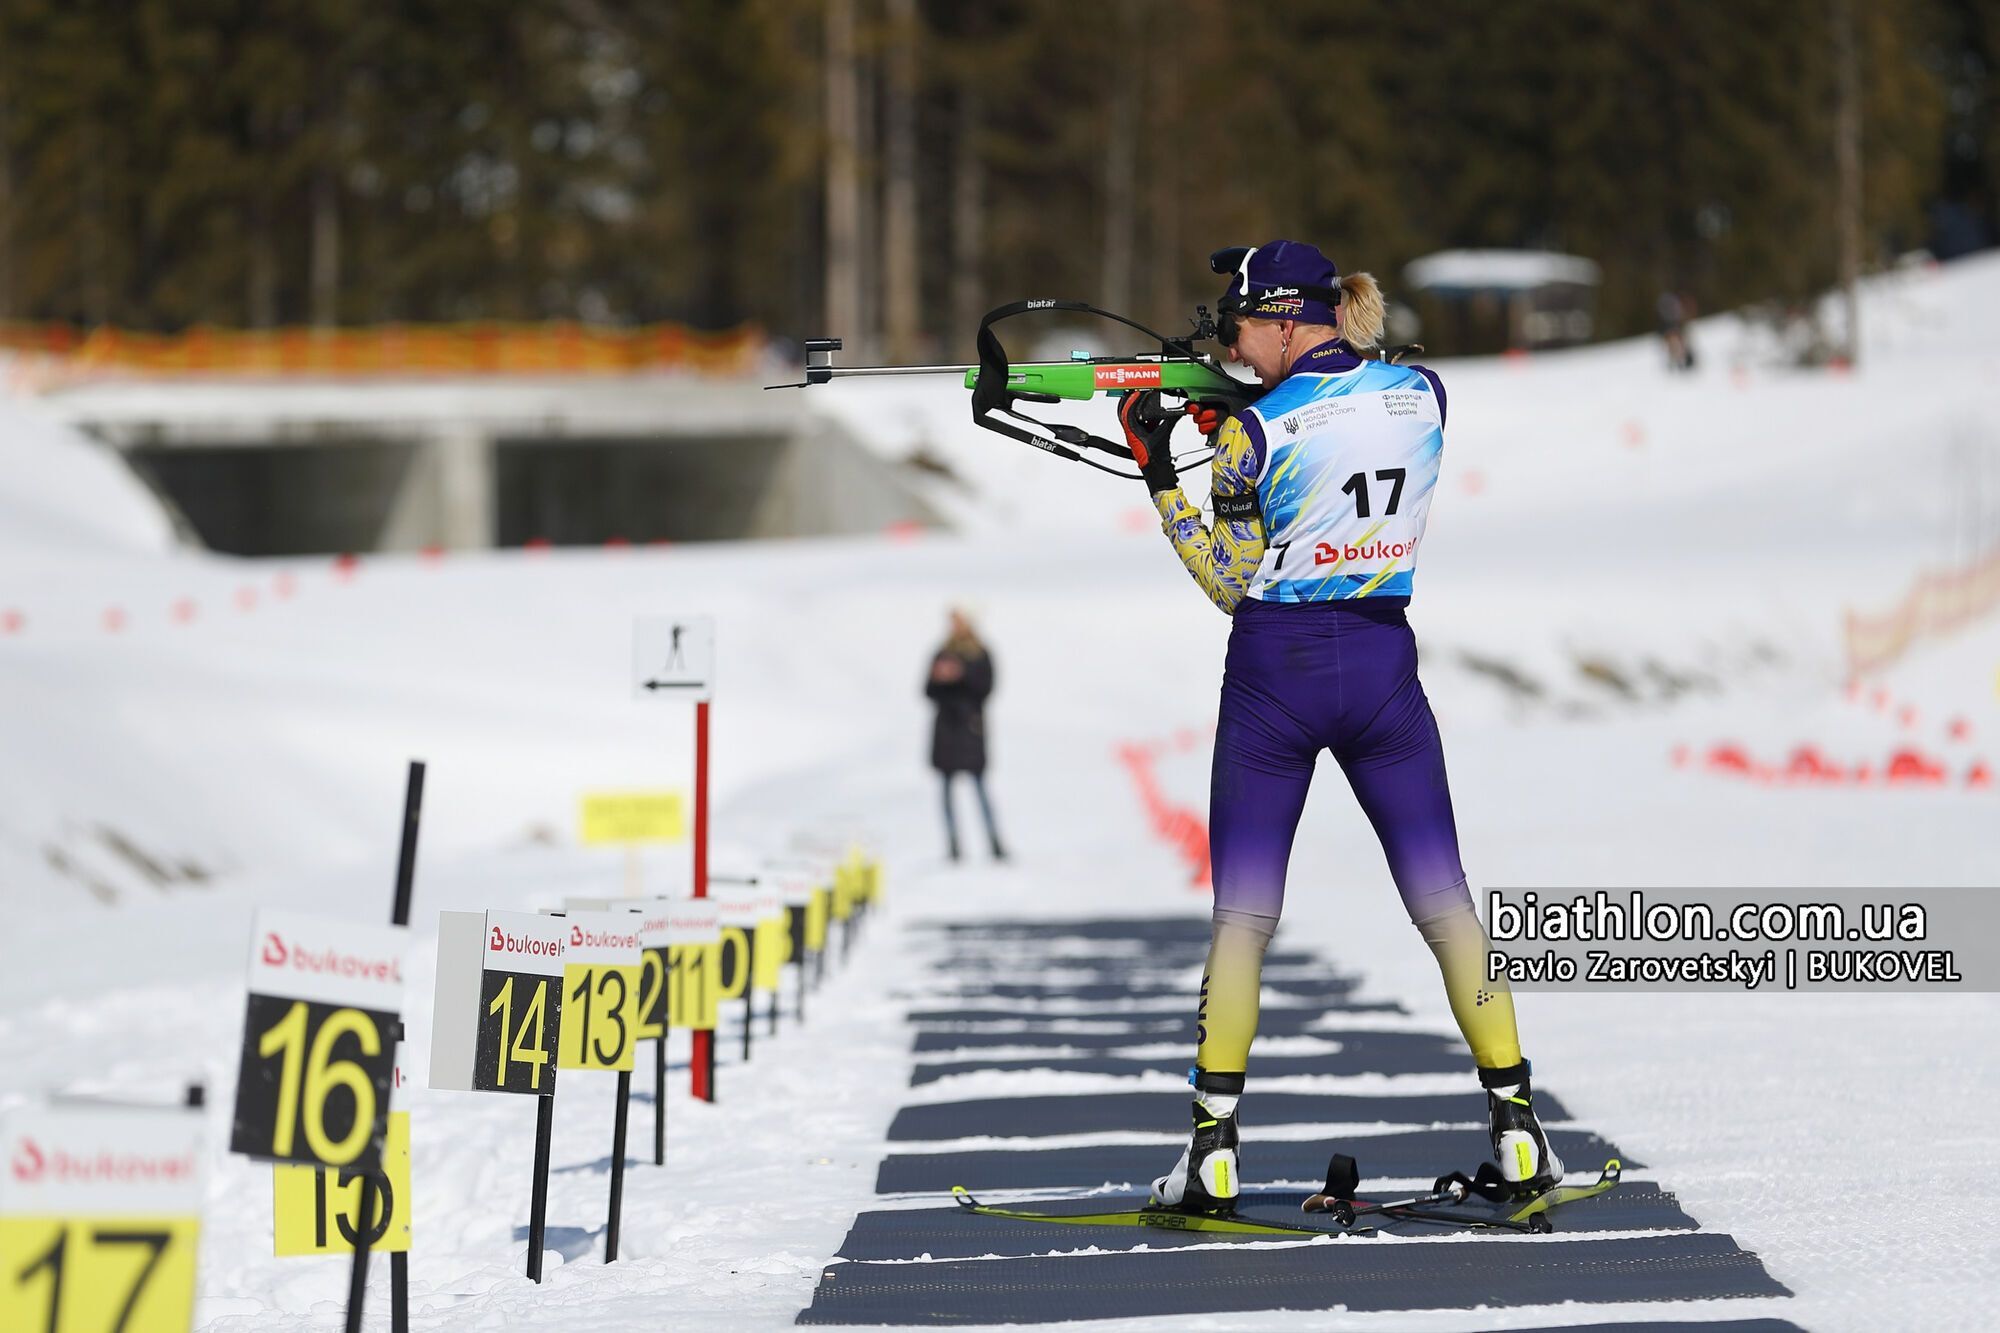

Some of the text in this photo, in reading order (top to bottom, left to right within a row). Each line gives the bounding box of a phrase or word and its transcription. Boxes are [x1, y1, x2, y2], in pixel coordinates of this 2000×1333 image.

[1027, 299, 1056, 309] biatar
[1260, 286, 1299, 300] Julbo
[1312, 347, 1338, 359] CRAFT
[1096, 368, 1159, 383] VIESSMANN
[1030, 436, 1057, 453] biatar
[1232, 502, 1253, 512] biatar
[1341, 468, 1406, 518] 17
[507, 932, 562, 957] bukovel
[293, 942, 400, 984] bukovel
[721, 927, 750, 998] 0
[637, 949, 664, 1040] 2
[489, 976, 549, 1090] 14
[572, 969, 627, 1066] 13
[258, 1000, 382, 1166] 16
[1138, 1214, 1187, 1229] FISCHER
[16, 1222, 174, 1333] 17
